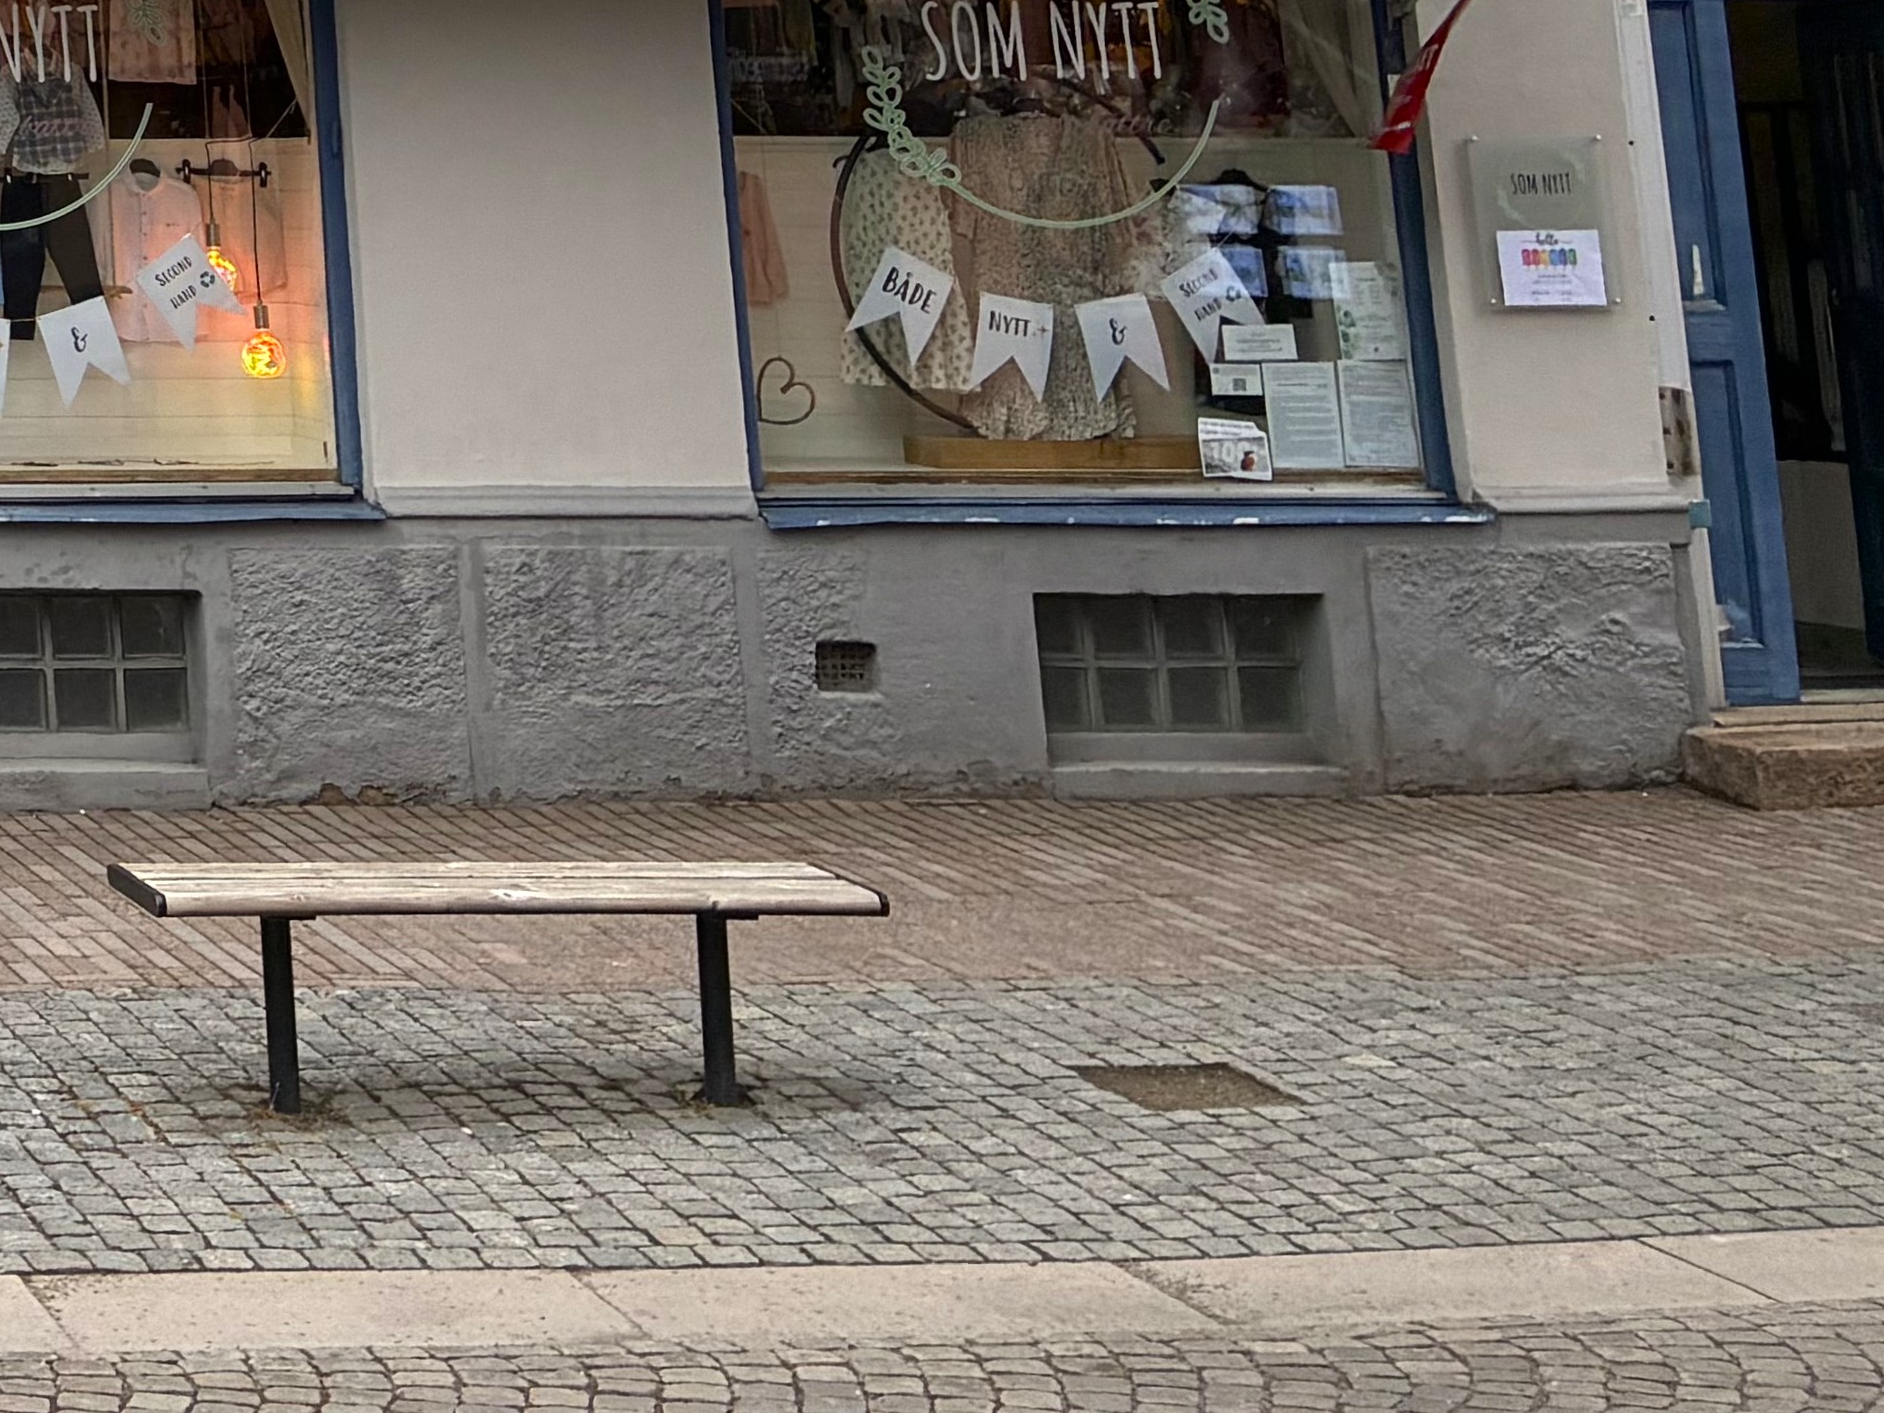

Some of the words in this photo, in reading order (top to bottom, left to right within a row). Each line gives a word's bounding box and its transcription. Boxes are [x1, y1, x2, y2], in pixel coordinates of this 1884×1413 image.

[921, 0, 1027, 81] SOM
[1049, 0, 1162, 80] NYTT
[1510, 173, 1538, 195] SOM
[1542, 172, 1572, 195] NYTT
[881, 266, 937, 314] BÅDE
[988, 310, 1031, 338] NYTT
[1108, 318, 1127, 345] &
[70, 326, 88, 353] &
